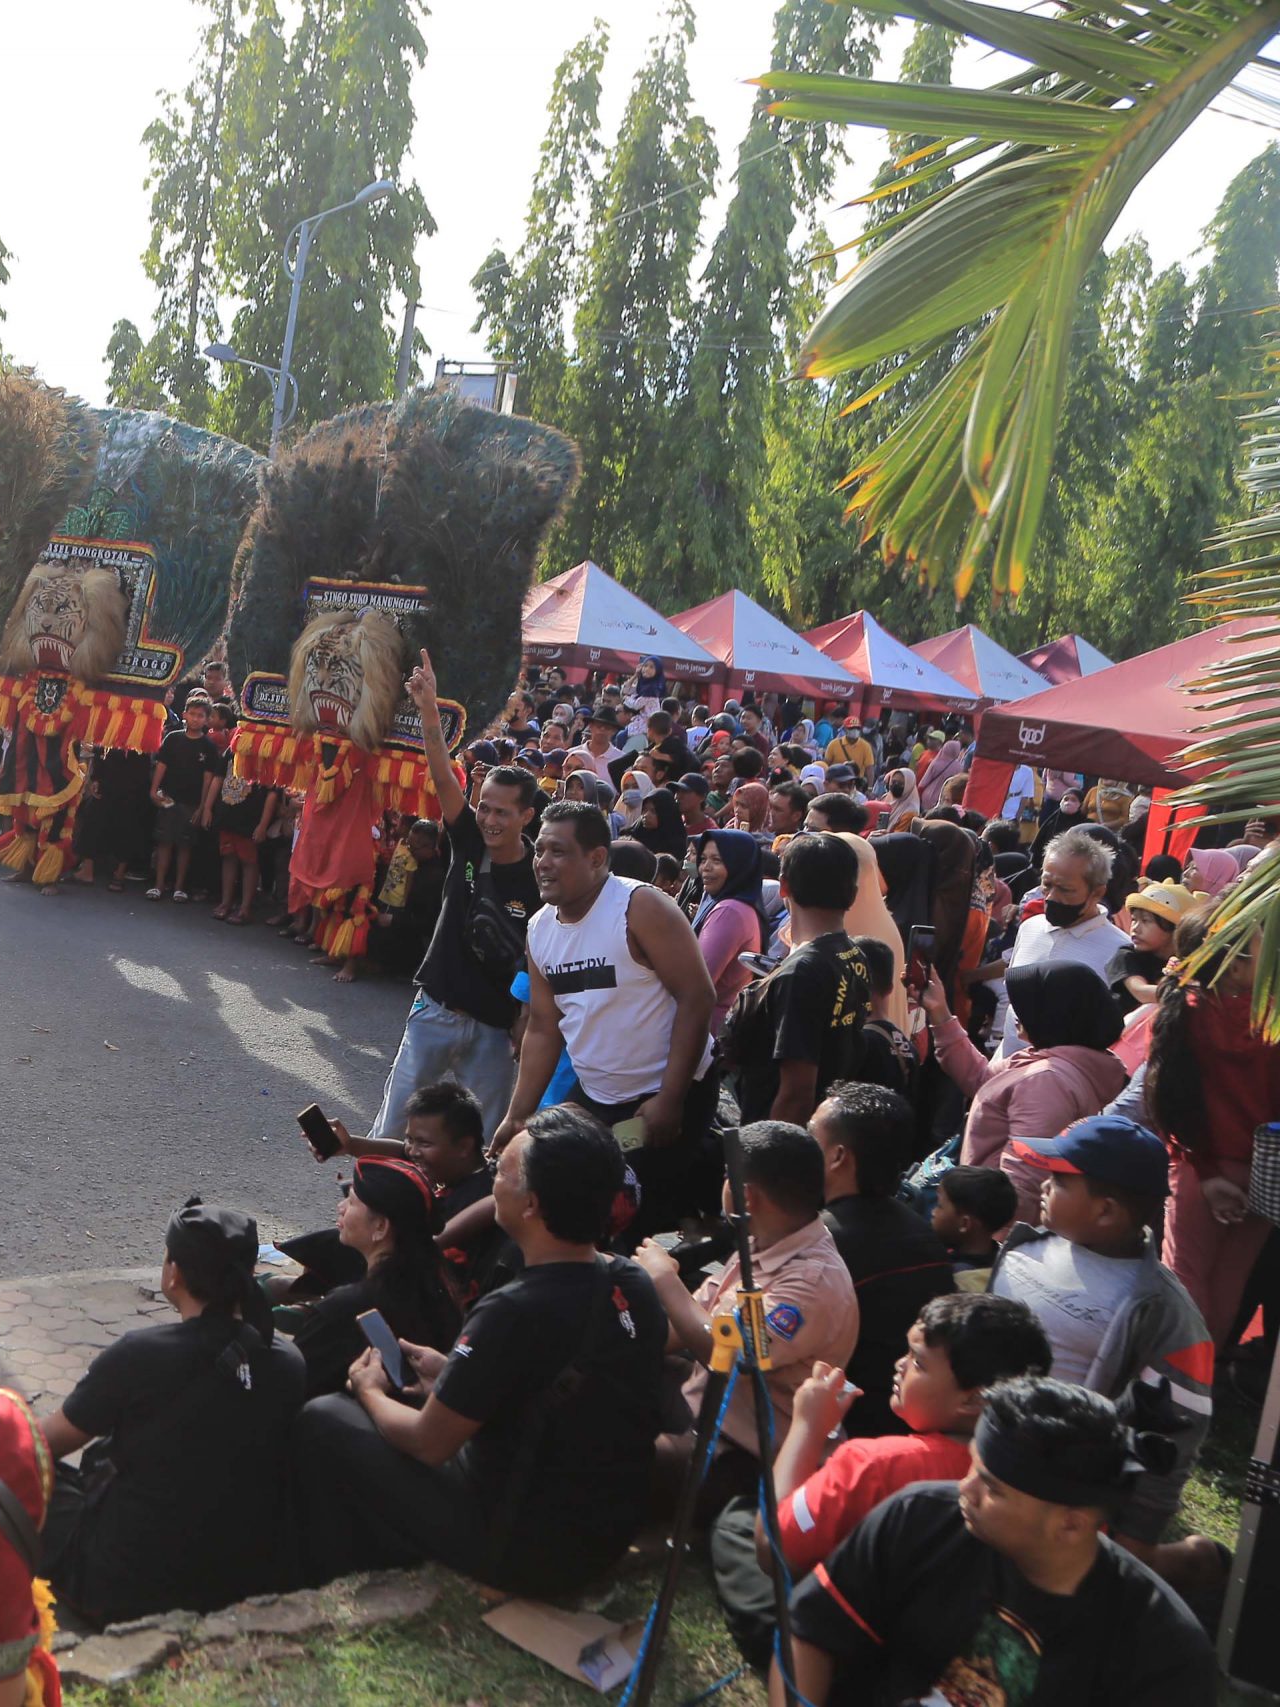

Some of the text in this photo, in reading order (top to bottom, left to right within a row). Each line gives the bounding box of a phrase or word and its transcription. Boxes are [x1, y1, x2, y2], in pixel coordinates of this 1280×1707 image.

[71, 546, 129, 561] BONGKOTAN
[323, 591, 347, 603] SINGO
[348, 593, 369, 604] SUKO
